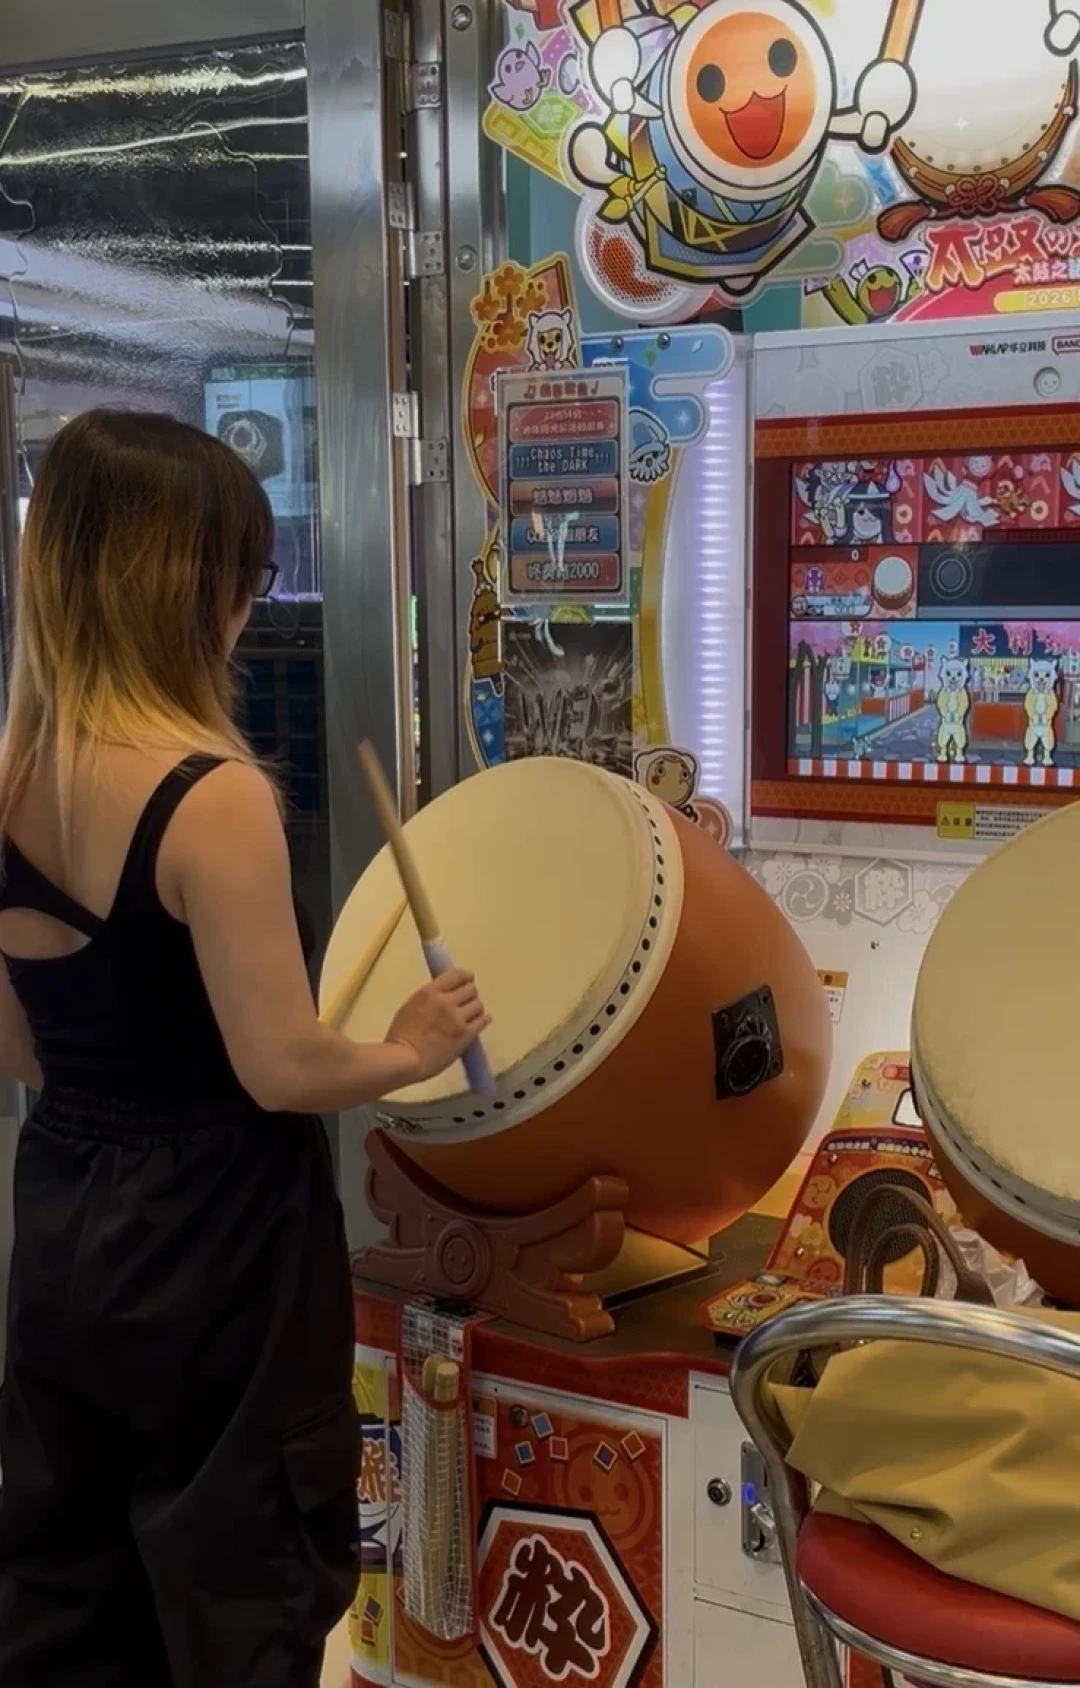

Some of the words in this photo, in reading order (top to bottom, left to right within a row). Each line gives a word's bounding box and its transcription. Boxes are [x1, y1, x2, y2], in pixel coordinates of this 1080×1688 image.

[530, 447, 563, 460] Chaos
[570, 446, 595, 459] Time
[538, 460, 556, 473] the
[562, 458, 589, 472] DARK
